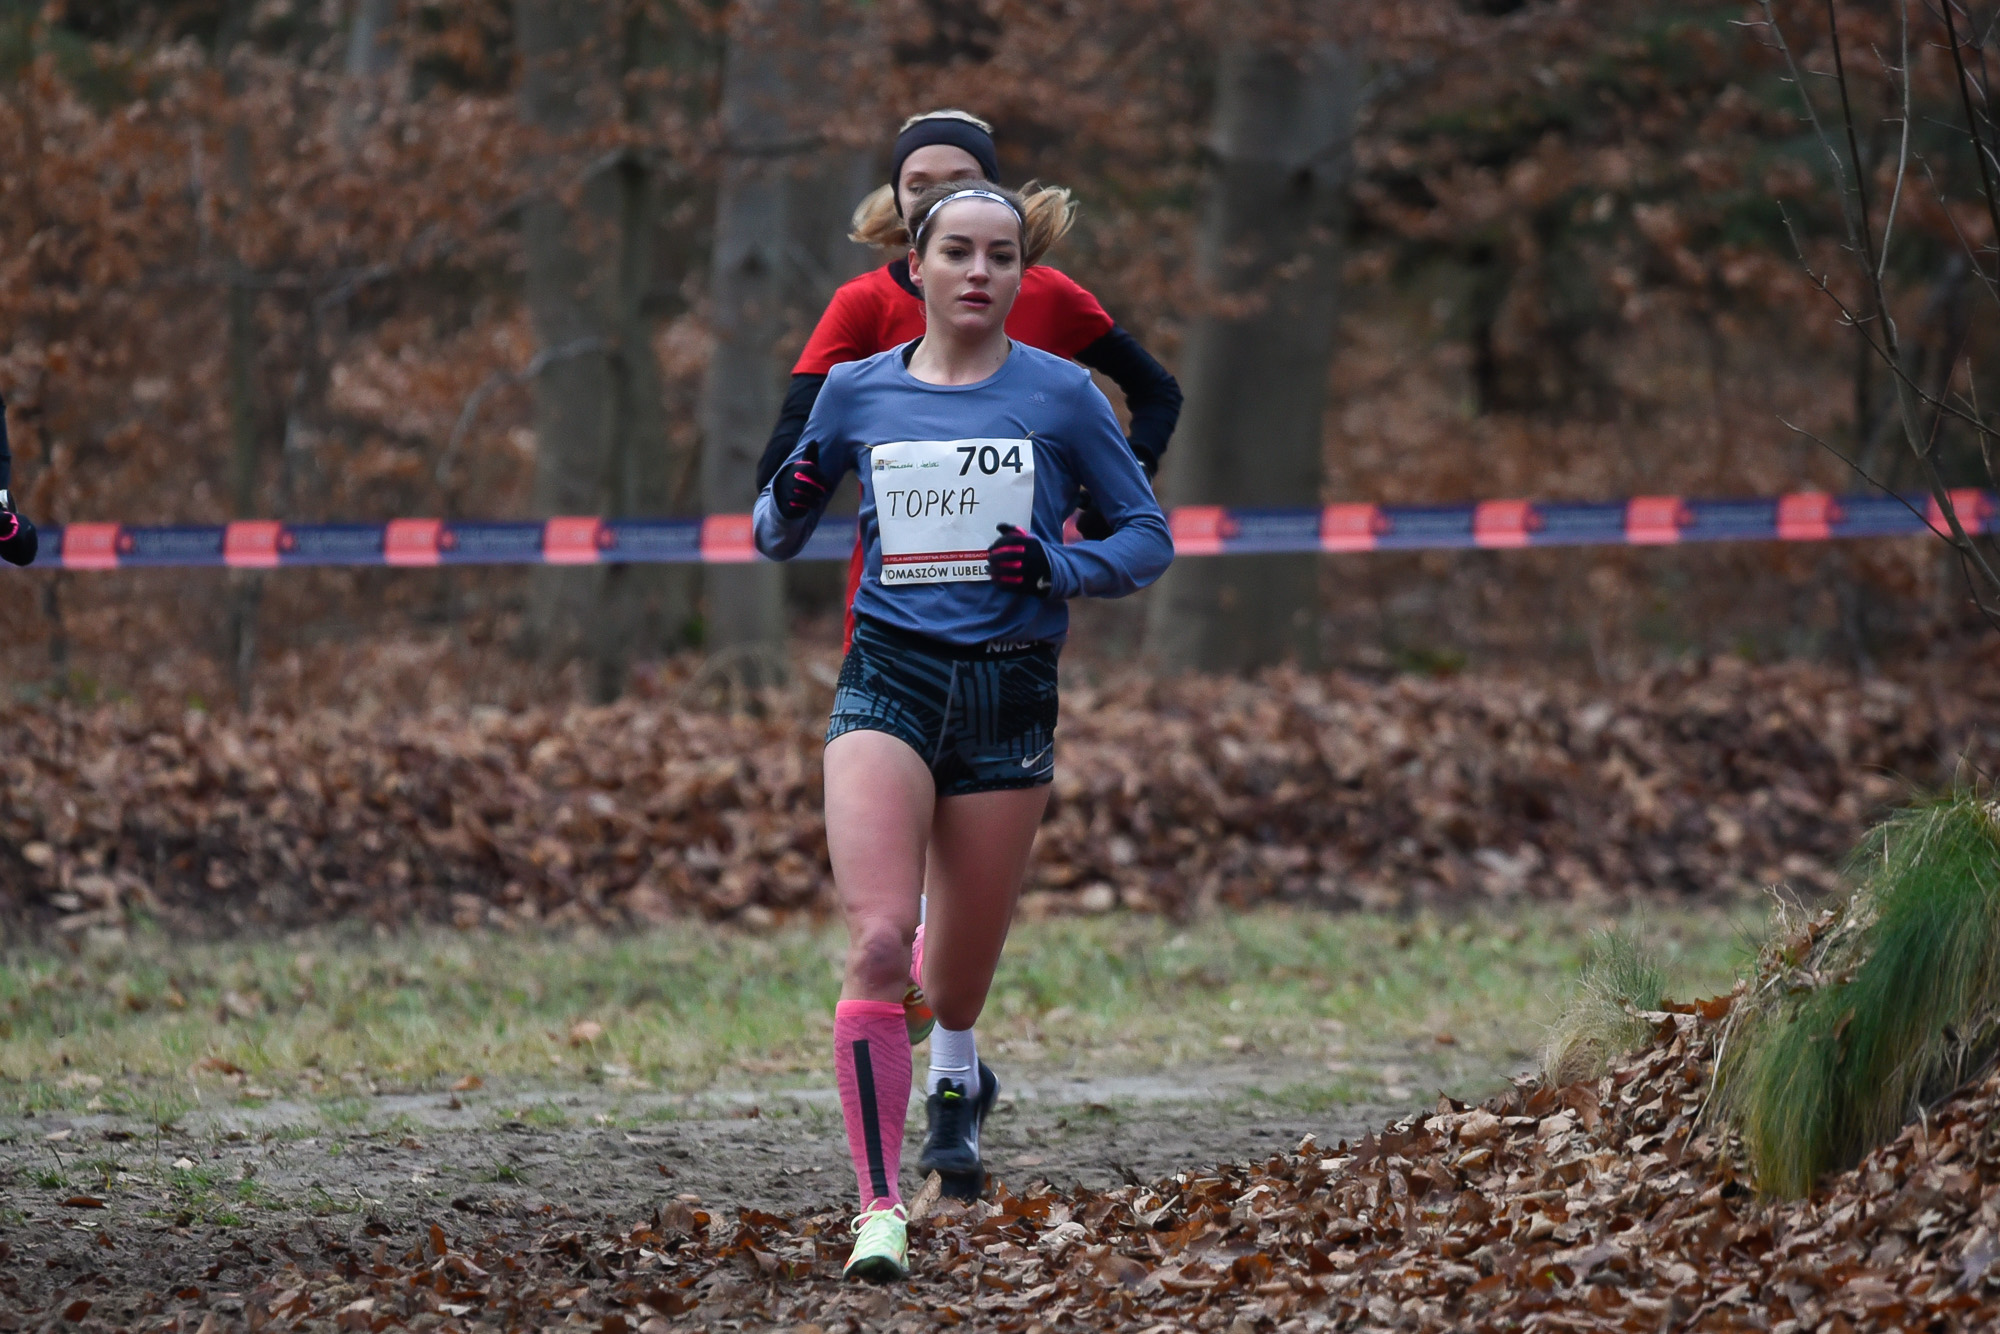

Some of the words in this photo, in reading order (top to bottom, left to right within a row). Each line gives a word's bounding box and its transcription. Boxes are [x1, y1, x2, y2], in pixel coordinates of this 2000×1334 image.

[957, 446, 1023, 476] 704
[886, 487, 980, 518] TOPKA
[952, 565, 989, 577] LUBELS
